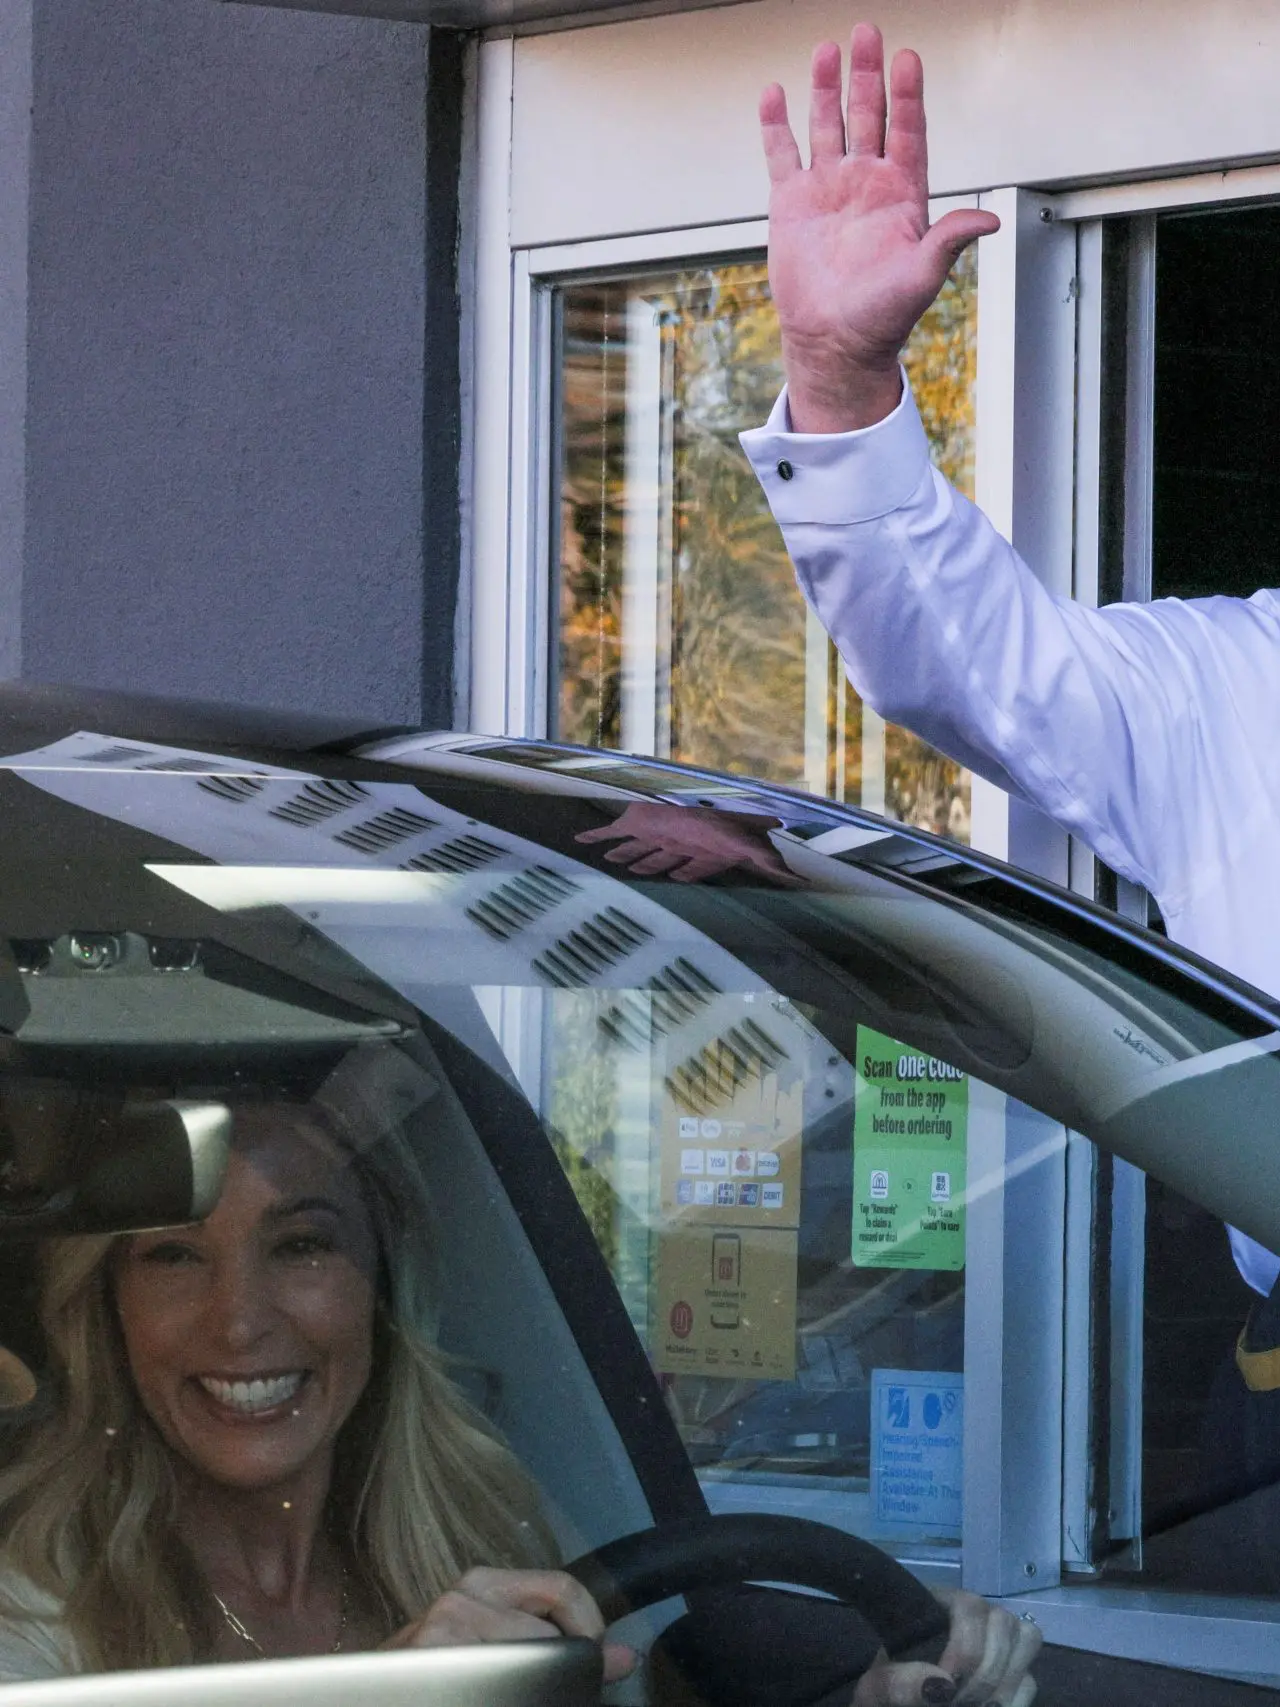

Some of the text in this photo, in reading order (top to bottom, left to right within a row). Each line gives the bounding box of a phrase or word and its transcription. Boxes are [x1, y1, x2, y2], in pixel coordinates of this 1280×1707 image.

[864, 1055, 892, 1078] Scan
[897, 1055, 926, 1080] one
[880, 1086, 946, 1113] from the app
[873, 1113, 952, 1141] before ordering
[710, 1156, 726, 1169] VISA
[763, 1191, 781, 1201] DEBIT
